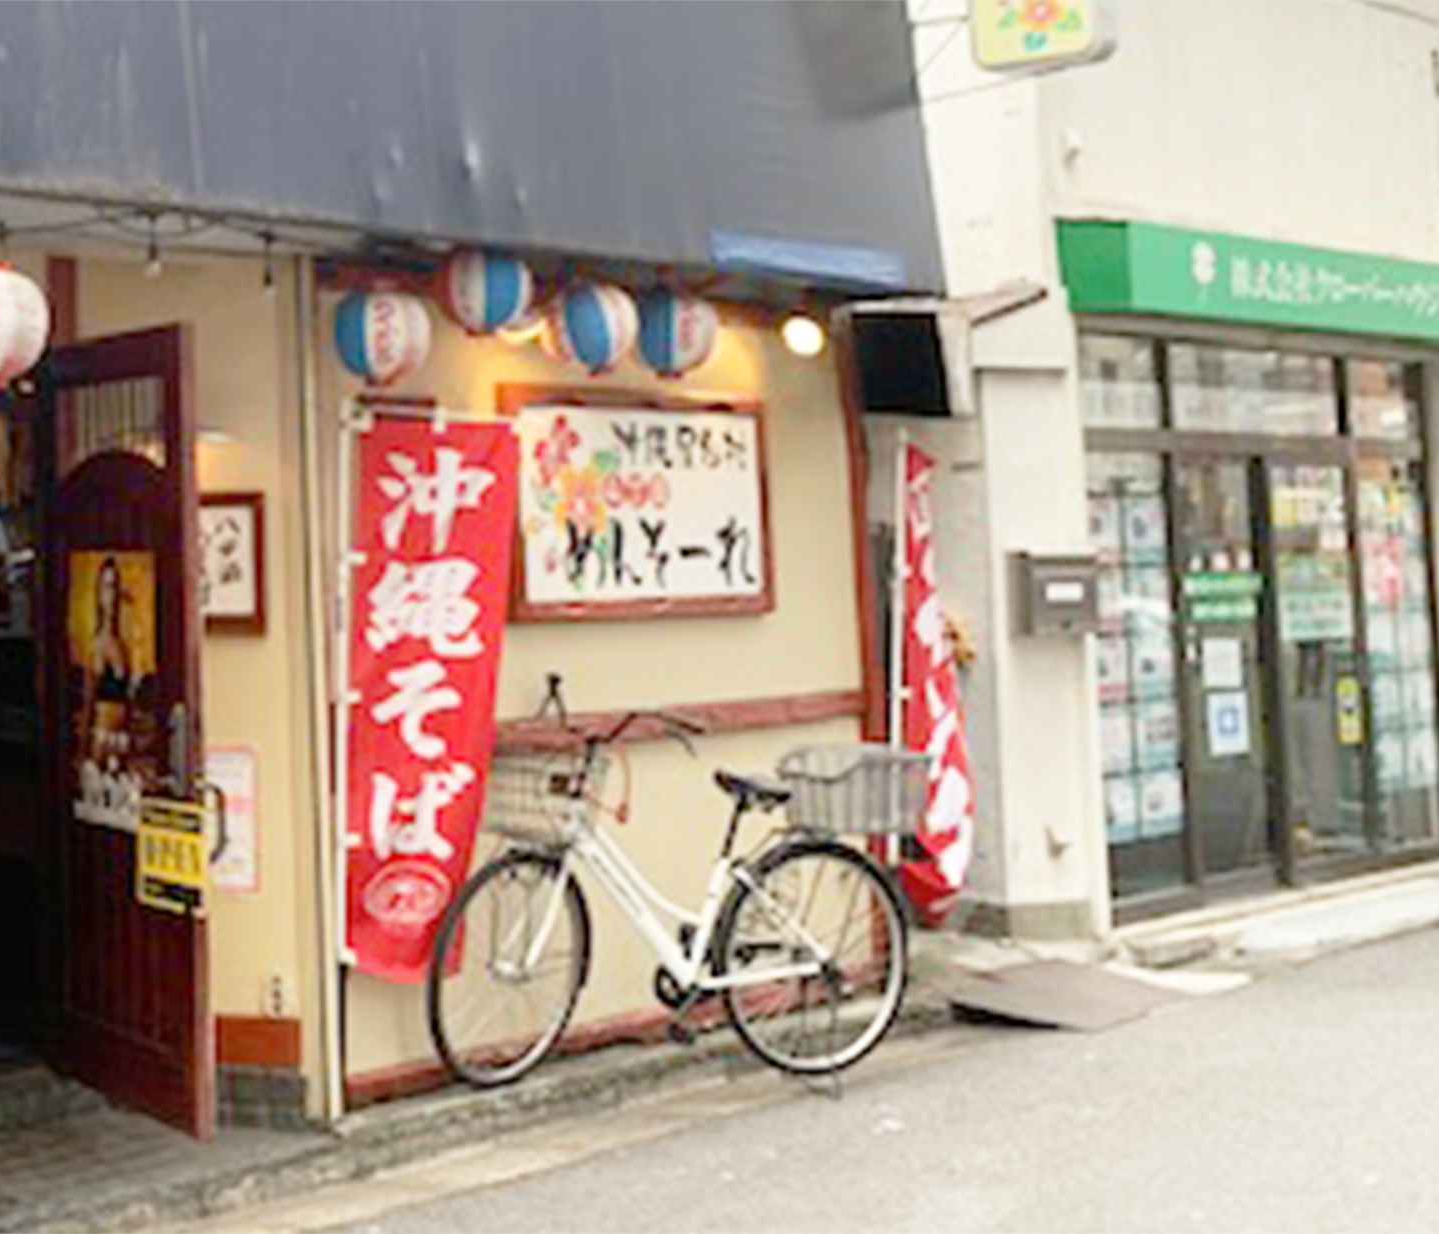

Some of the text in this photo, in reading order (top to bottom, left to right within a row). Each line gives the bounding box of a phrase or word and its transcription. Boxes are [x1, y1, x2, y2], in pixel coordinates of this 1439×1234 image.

[364, 447, 497, 860] 沖縄そば
[564, 516, 757, 590] めんそーれ
